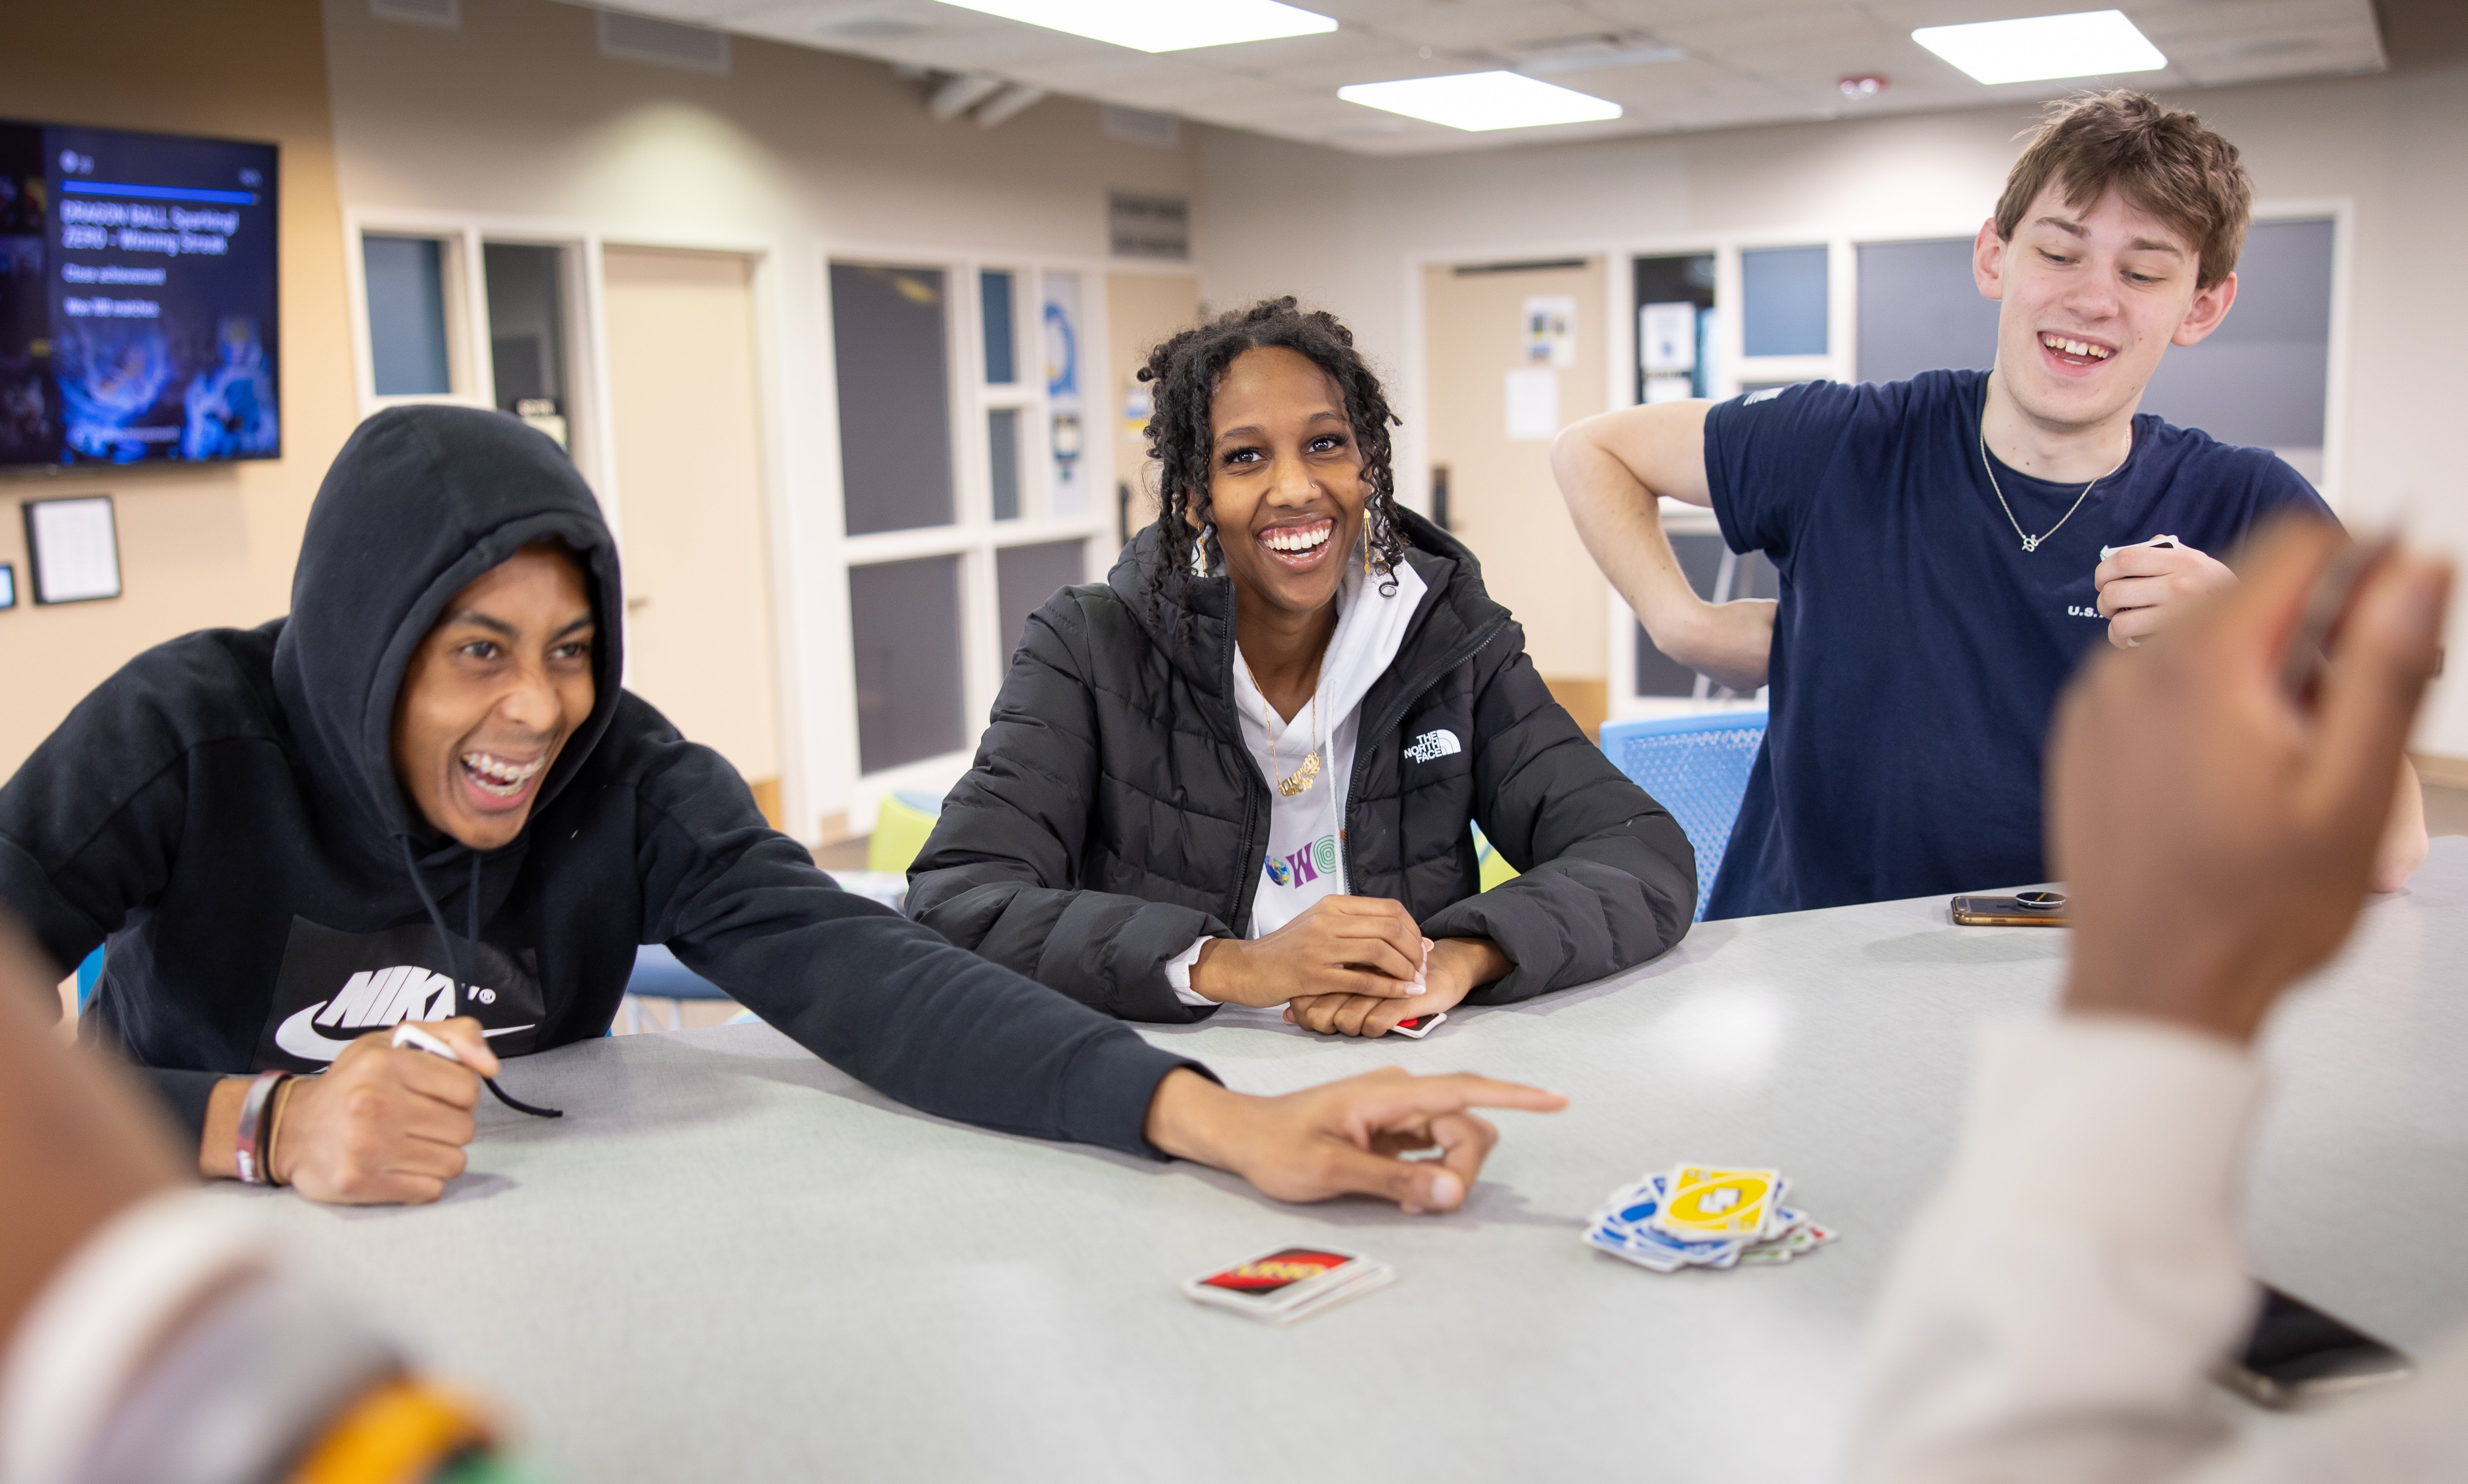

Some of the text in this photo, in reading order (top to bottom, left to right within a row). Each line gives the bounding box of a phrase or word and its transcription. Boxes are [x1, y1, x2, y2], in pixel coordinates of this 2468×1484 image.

[2067, 605, 2103, 618] U.S.
[1416, 730, 1438, 744] THE
[1404, 738, 1440, 759] NORTH
[1416, 747, 1442, 764] FACE
